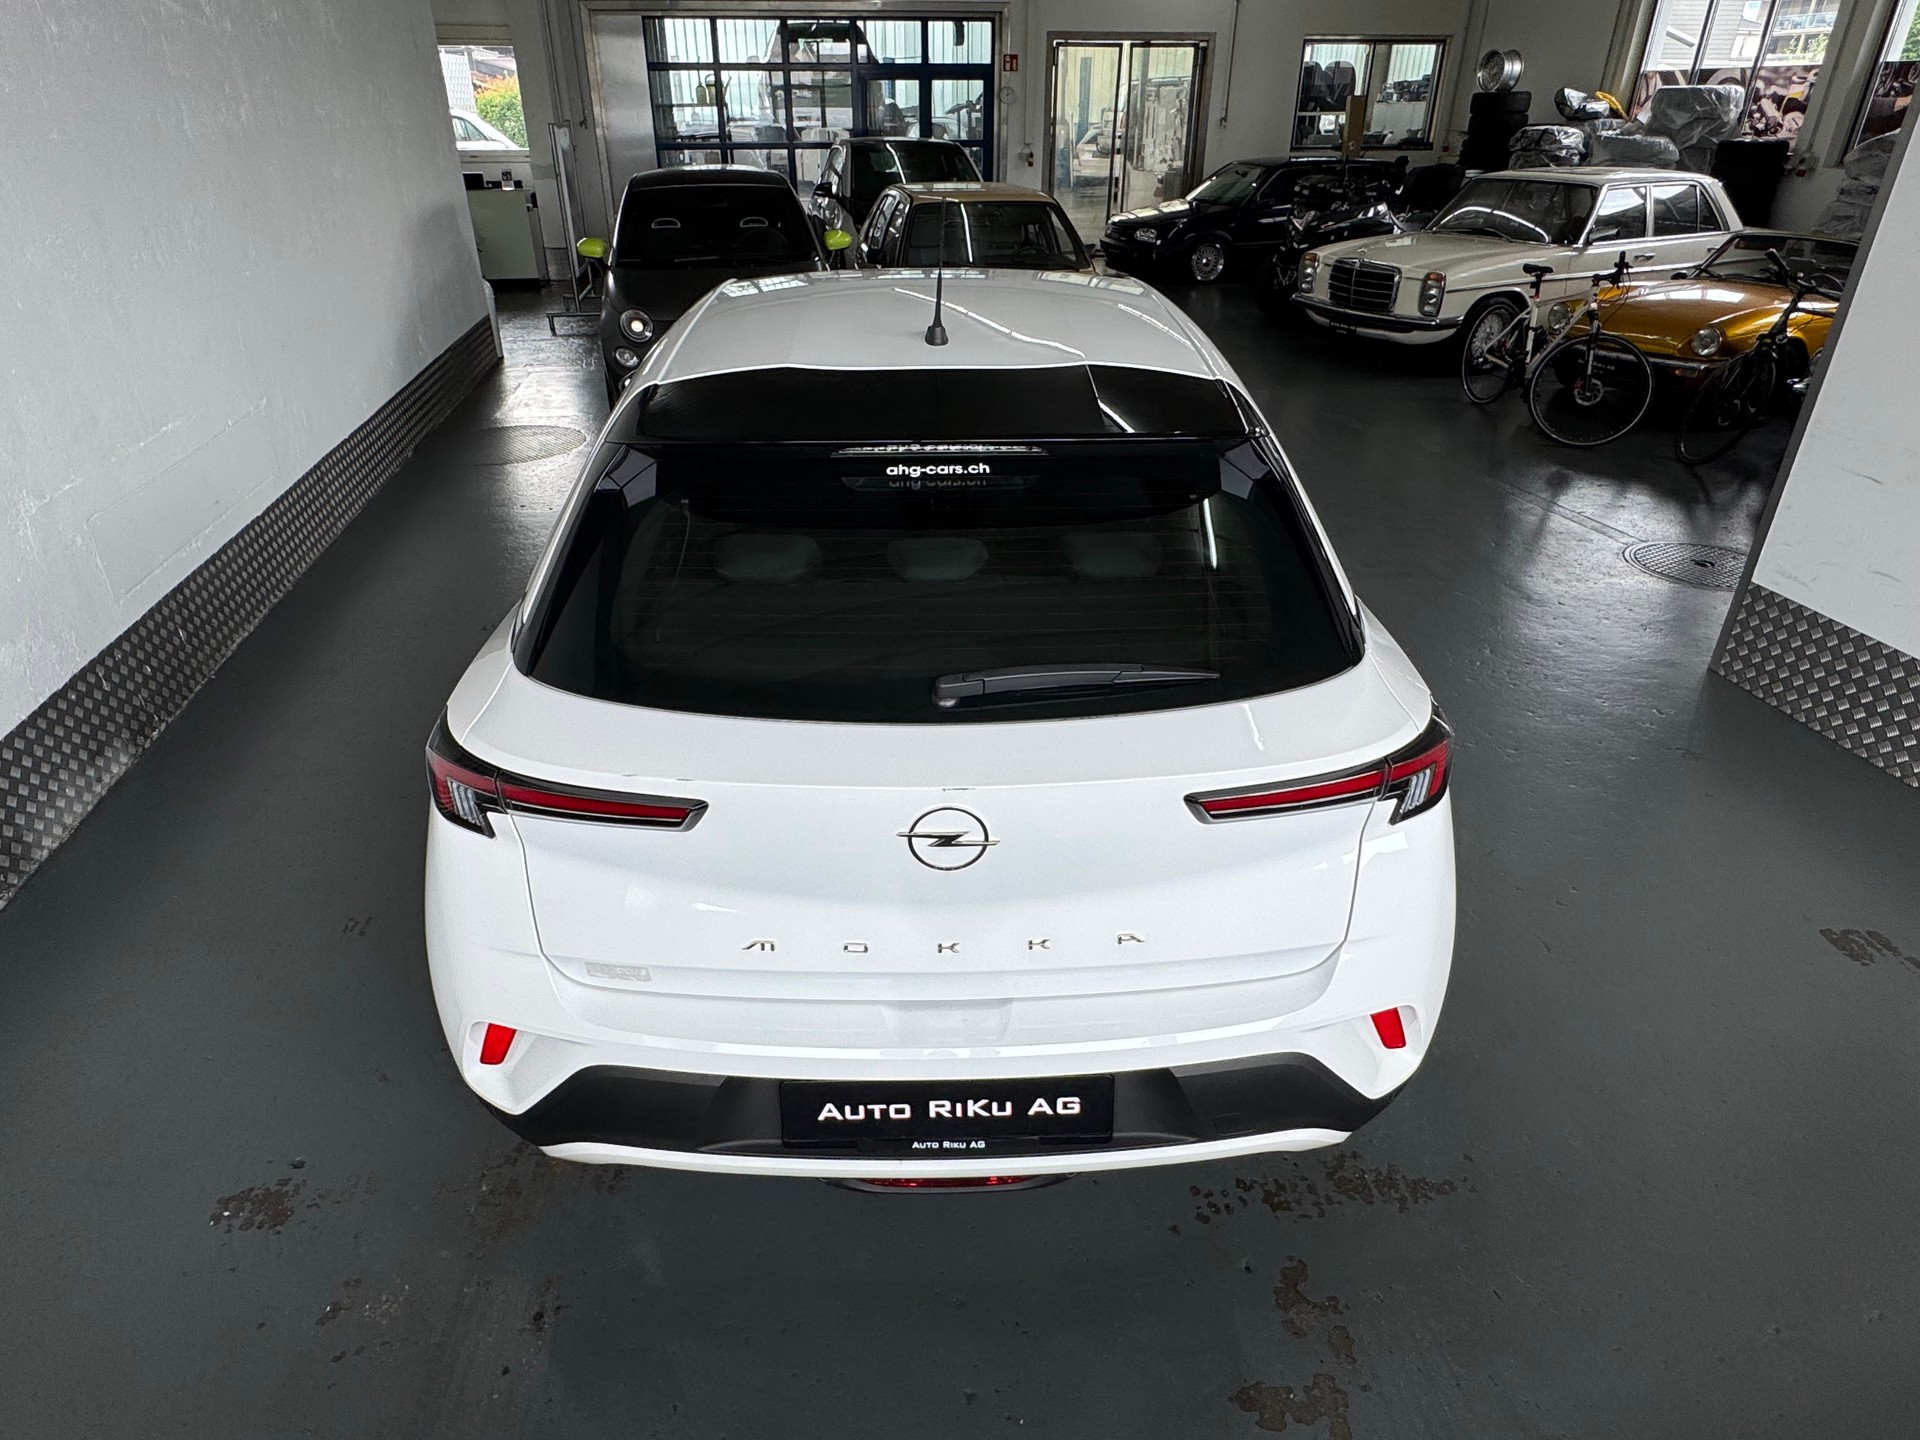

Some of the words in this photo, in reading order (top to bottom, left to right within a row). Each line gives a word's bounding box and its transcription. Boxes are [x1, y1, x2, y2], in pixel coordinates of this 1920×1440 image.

[885, 463, 991, 478] ahg-cars.ch
[742, 933, 1146, 954] MOKKA
[817, 1103, 912, 1121] AUTO
[1027, 1096, 1081, 1116] AG
[969, 1141, 986, 1149] AG
